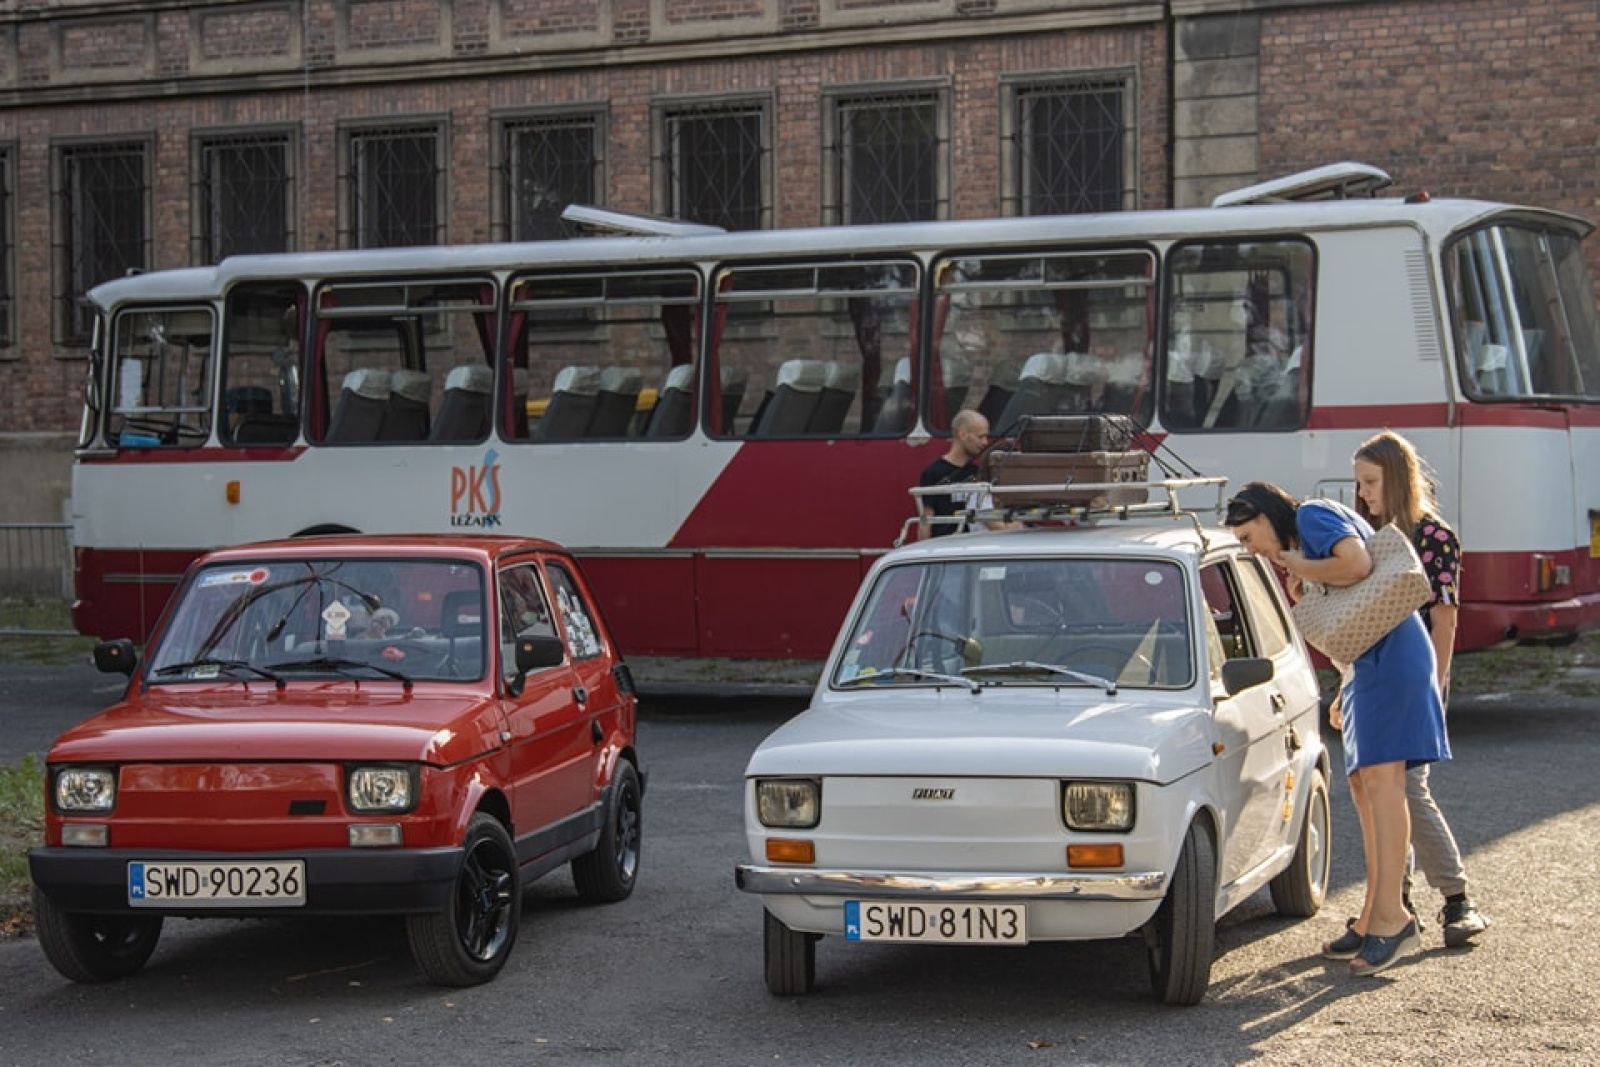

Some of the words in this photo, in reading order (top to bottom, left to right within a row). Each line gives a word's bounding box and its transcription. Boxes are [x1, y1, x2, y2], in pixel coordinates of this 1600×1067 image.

[451, 464, 502, 514] PKS
[912, 788, 956, 800] FIAT
[146, 867, 199, 897] SWD
[209, 867, 299, 897] 90236
[866, 905, 926, 938] SWD
[939, 907, 1018, 939] 81N3
